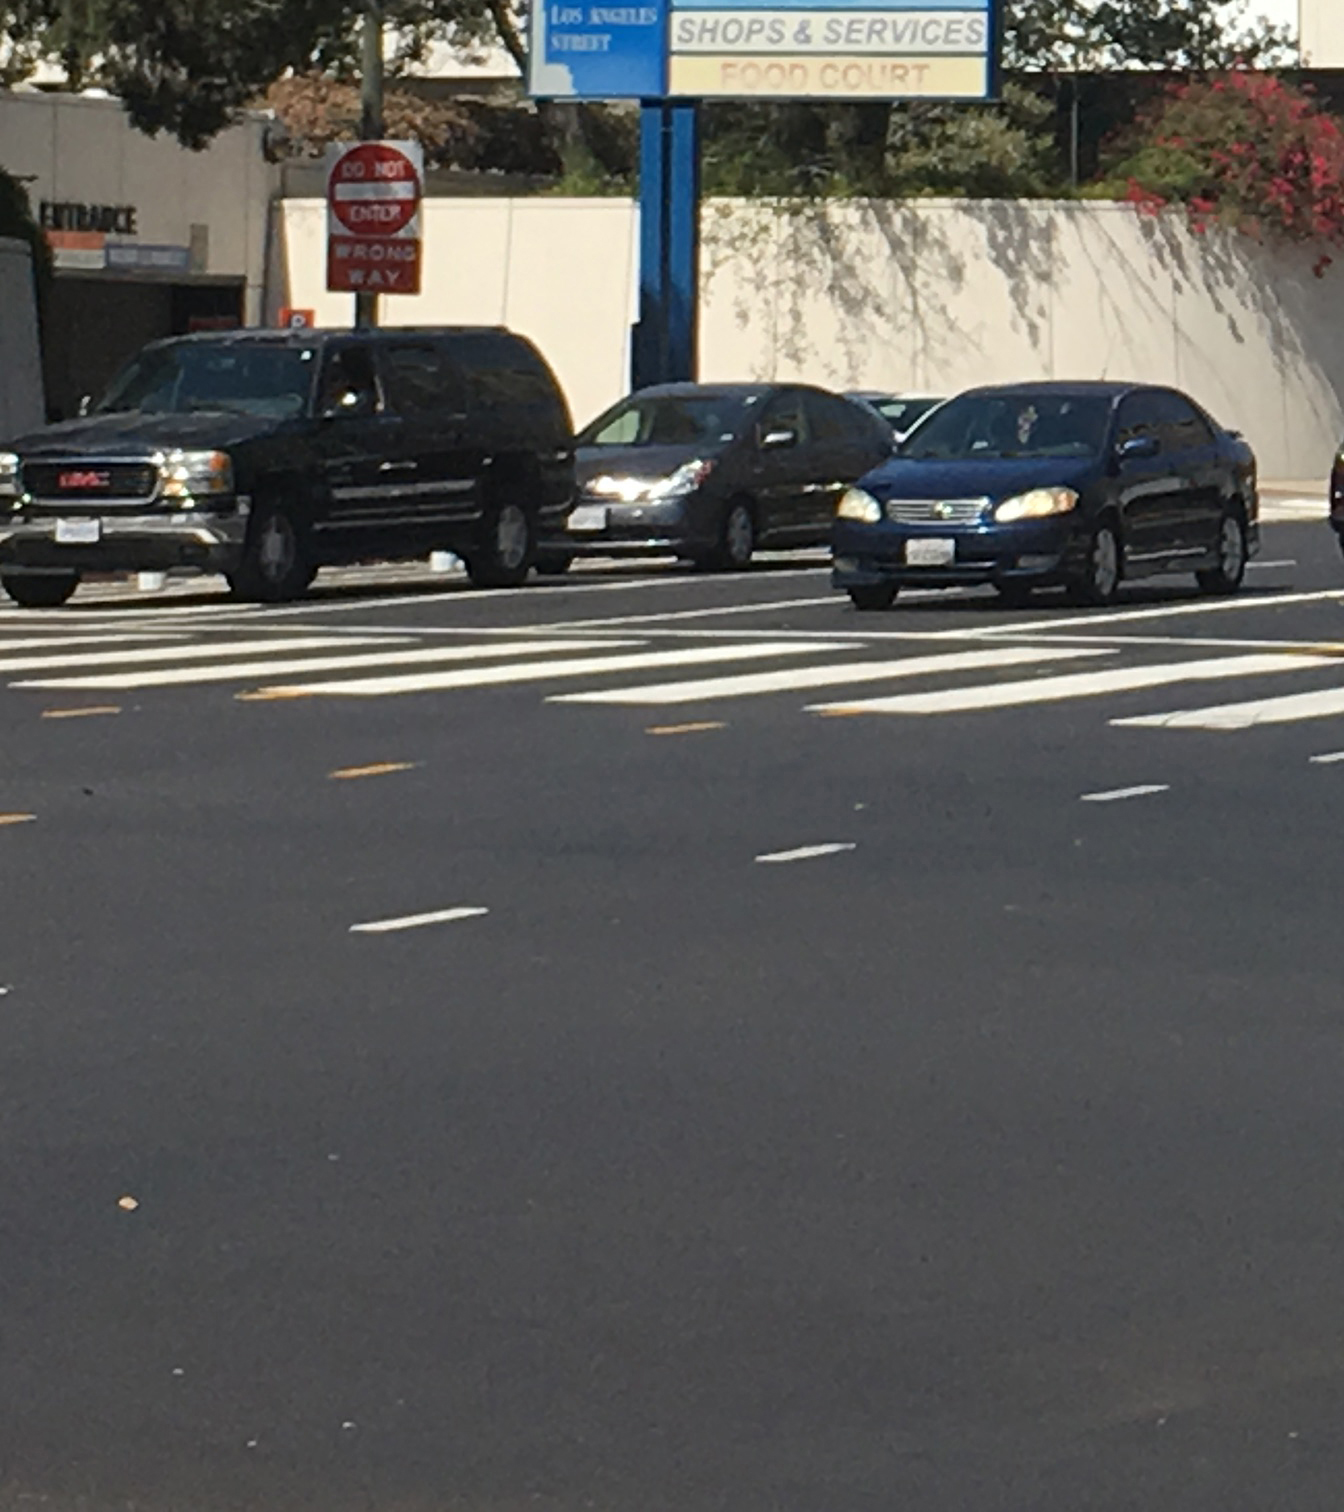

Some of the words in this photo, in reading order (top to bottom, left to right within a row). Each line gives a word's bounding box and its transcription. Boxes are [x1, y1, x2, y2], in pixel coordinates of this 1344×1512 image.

[551, 4, 583, 25] LOS
[588, 6, 658, 25] ANGELES
[677, 17, 786, 45] SHOPS
[793, 18, 813, 44] &
[822, 17, 985, 45] SERVICES
[719, 62, 808, 90] FOOD
[819, 62, 931, 90] COURT
[342, 162, 364, 177] DO
[374, 160, 405, 177] NOT
[40, 202, 137, 235] ENTRANCE
[351, 205, 402, 222] ENTER
[335, 243, 416, 261] WRONG
[348, 269, 399, 285] WAY
